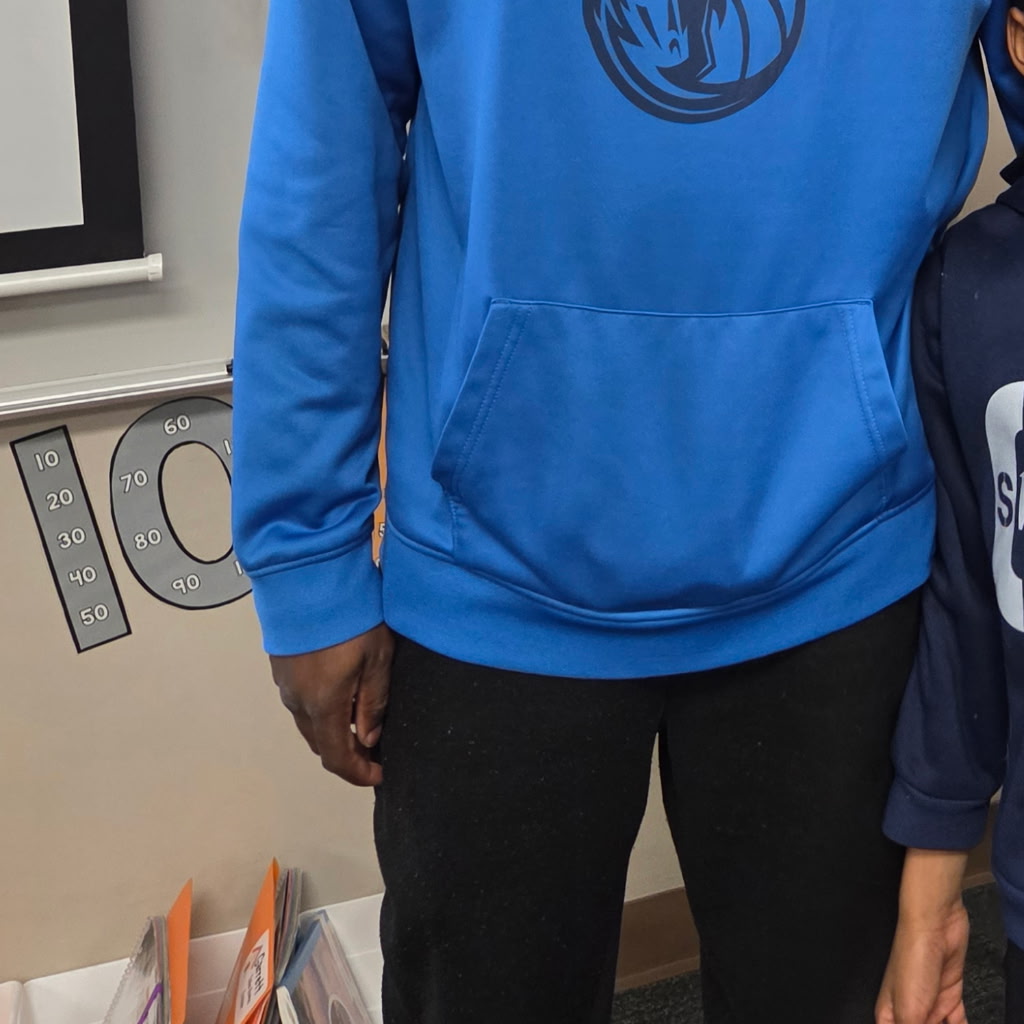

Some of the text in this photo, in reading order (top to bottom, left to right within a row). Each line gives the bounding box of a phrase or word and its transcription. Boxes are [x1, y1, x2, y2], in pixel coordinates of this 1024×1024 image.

[163, 415, 191, 435] 60
[34, 450, 60, 471] 10
[120, 470, 148, 493] 70
[46, 488, 74, 511] 20
[57, 528, 86, 549] 30
[134, 529, 162, 550] 80
[69, 566, 97, 587] 40
[172, 574, 201, 595] 90
[80, 604, 109, 626] 50
